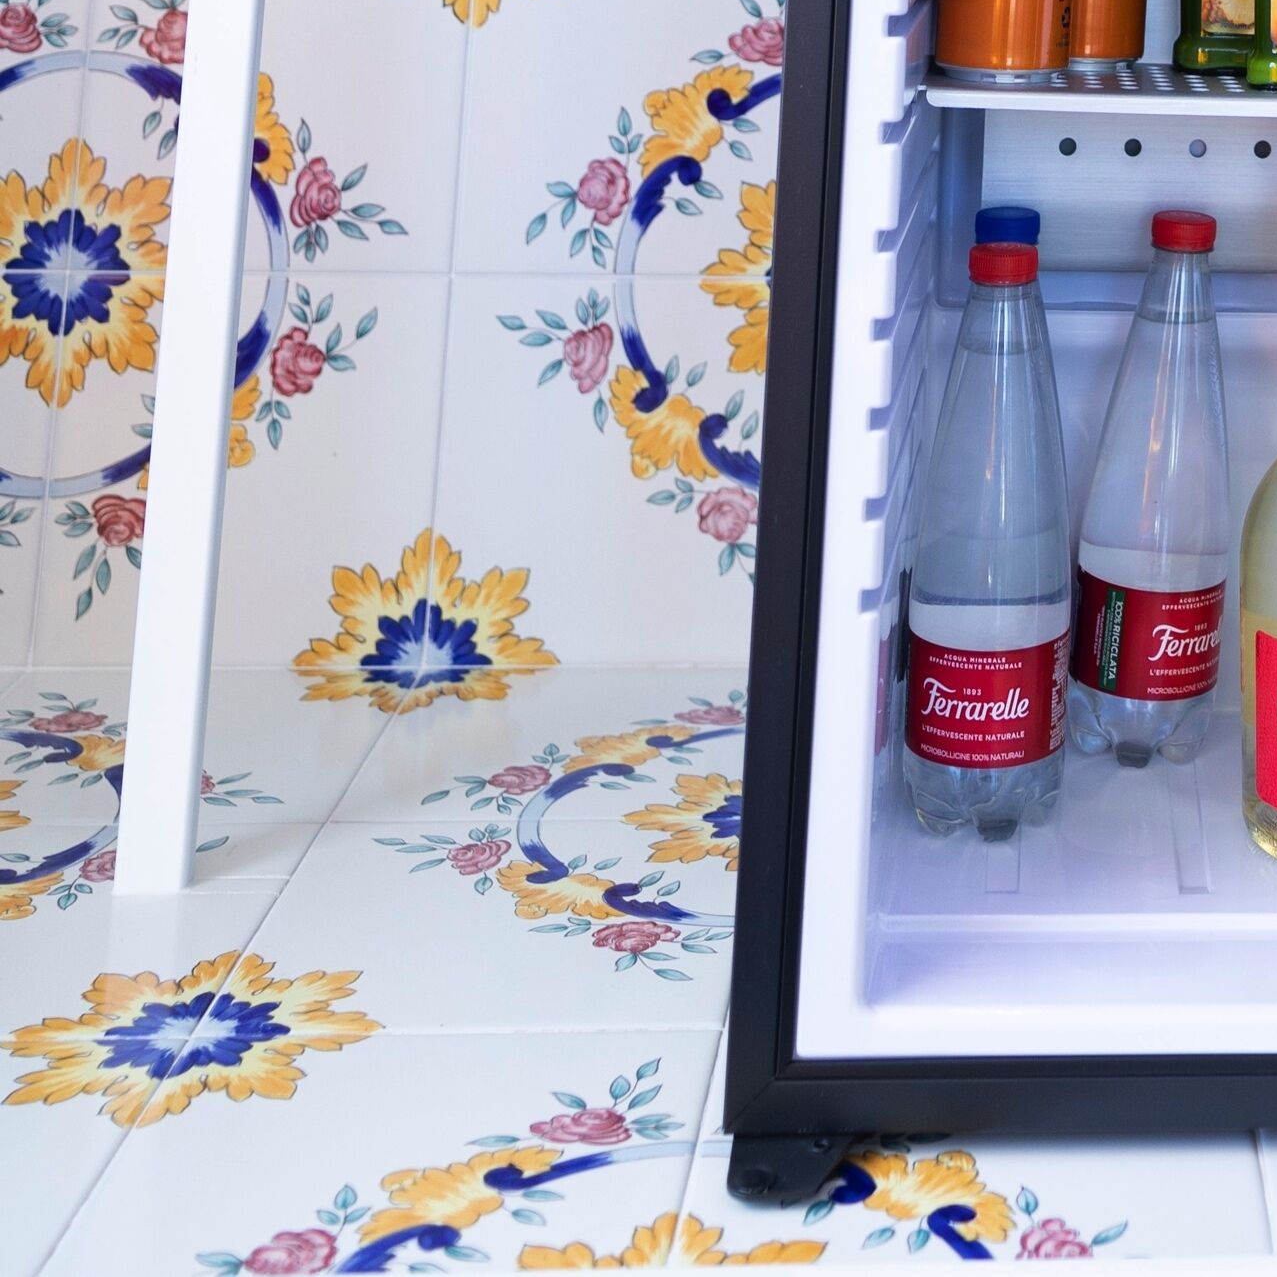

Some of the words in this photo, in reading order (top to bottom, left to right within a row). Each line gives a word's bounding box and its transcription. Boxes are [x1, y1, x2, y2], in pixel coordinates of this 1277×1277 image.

[1113, 601, 1123, 623] 100%
[944, 653, 967, 662] ACQUA
[1108, 625, 1121, 680] RICICLATA
[929, 656, 982, 670] EFFERVESCENTE
[985, 662, 1022, 670] NATURALE
[921, 677, 1030, 721] Ferrarelle
[963, 687, 982, 695] 1893
[922, 723, 983, 741] L'EFFERVESCENTE
[985, 731, 1025, 741] NATURALE
[921, 743, 970, 761] MICROBOLLICINE
[972, 753, 989, 762] 100%
[990, 751, 1025, 761] NATURALI
